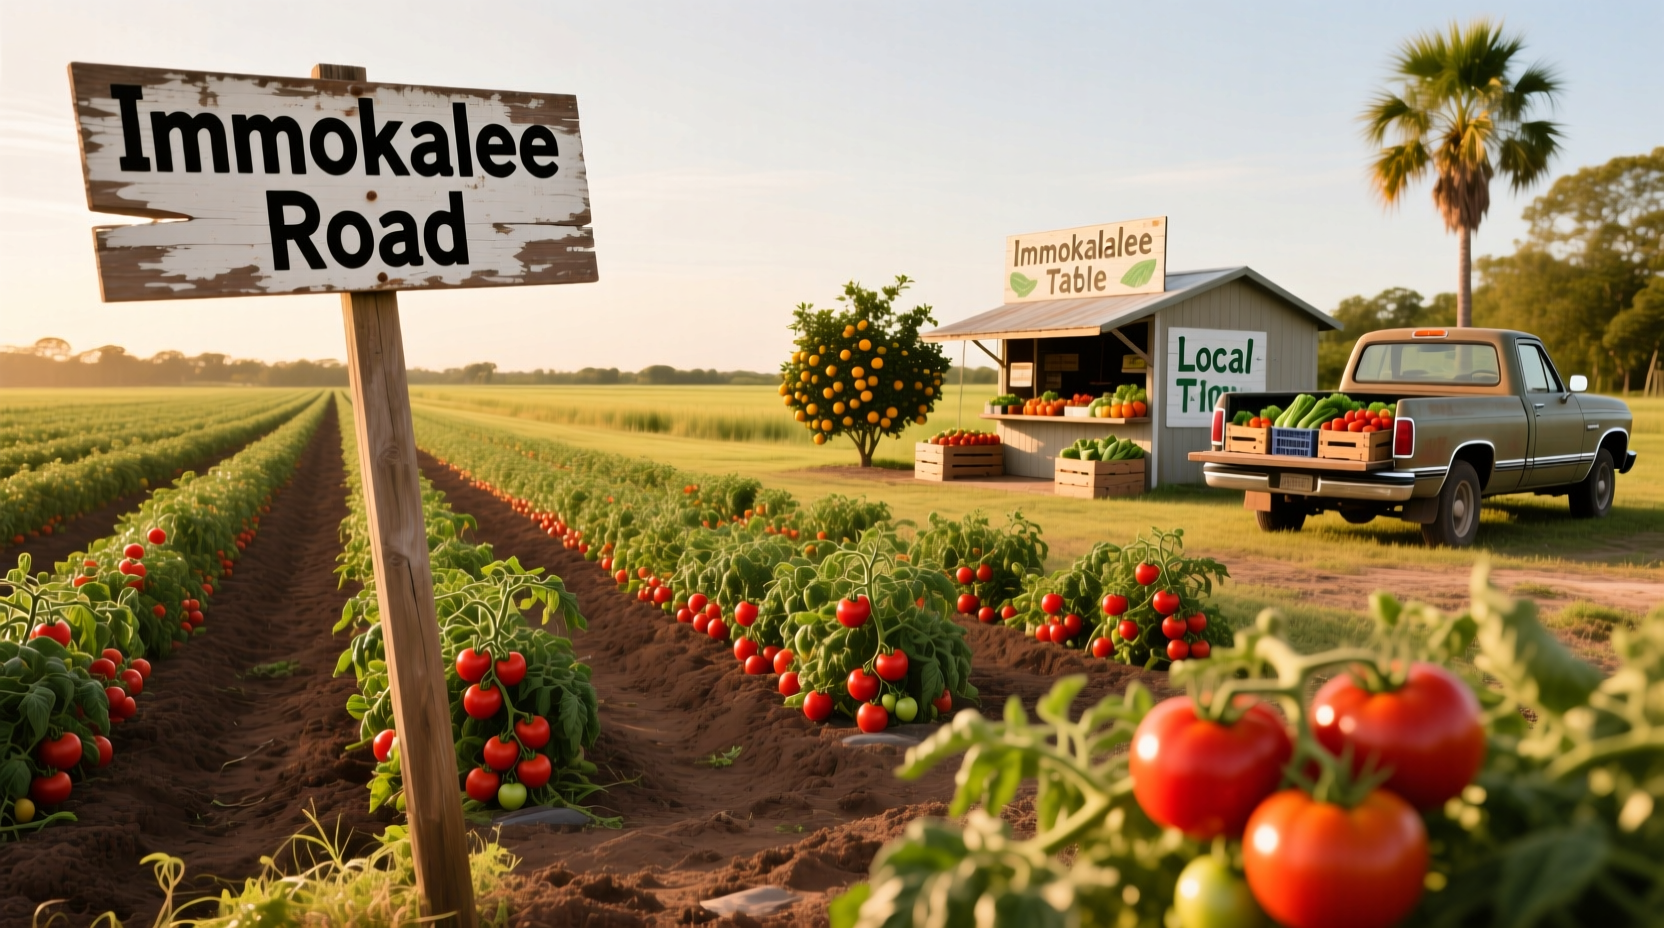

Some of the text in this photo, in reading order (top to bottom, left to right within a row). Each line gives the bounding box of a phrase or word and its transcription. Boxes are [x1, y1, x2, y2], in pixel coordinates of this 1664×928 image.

[109, 83, 560, 179] Immokalee
[265, 190, 470, 271] Road
[1013, 226, 1153, 268] Immokalalee
[1046, 265, 1107, 295] Table
[1177, 335, 1254, 375] Local
